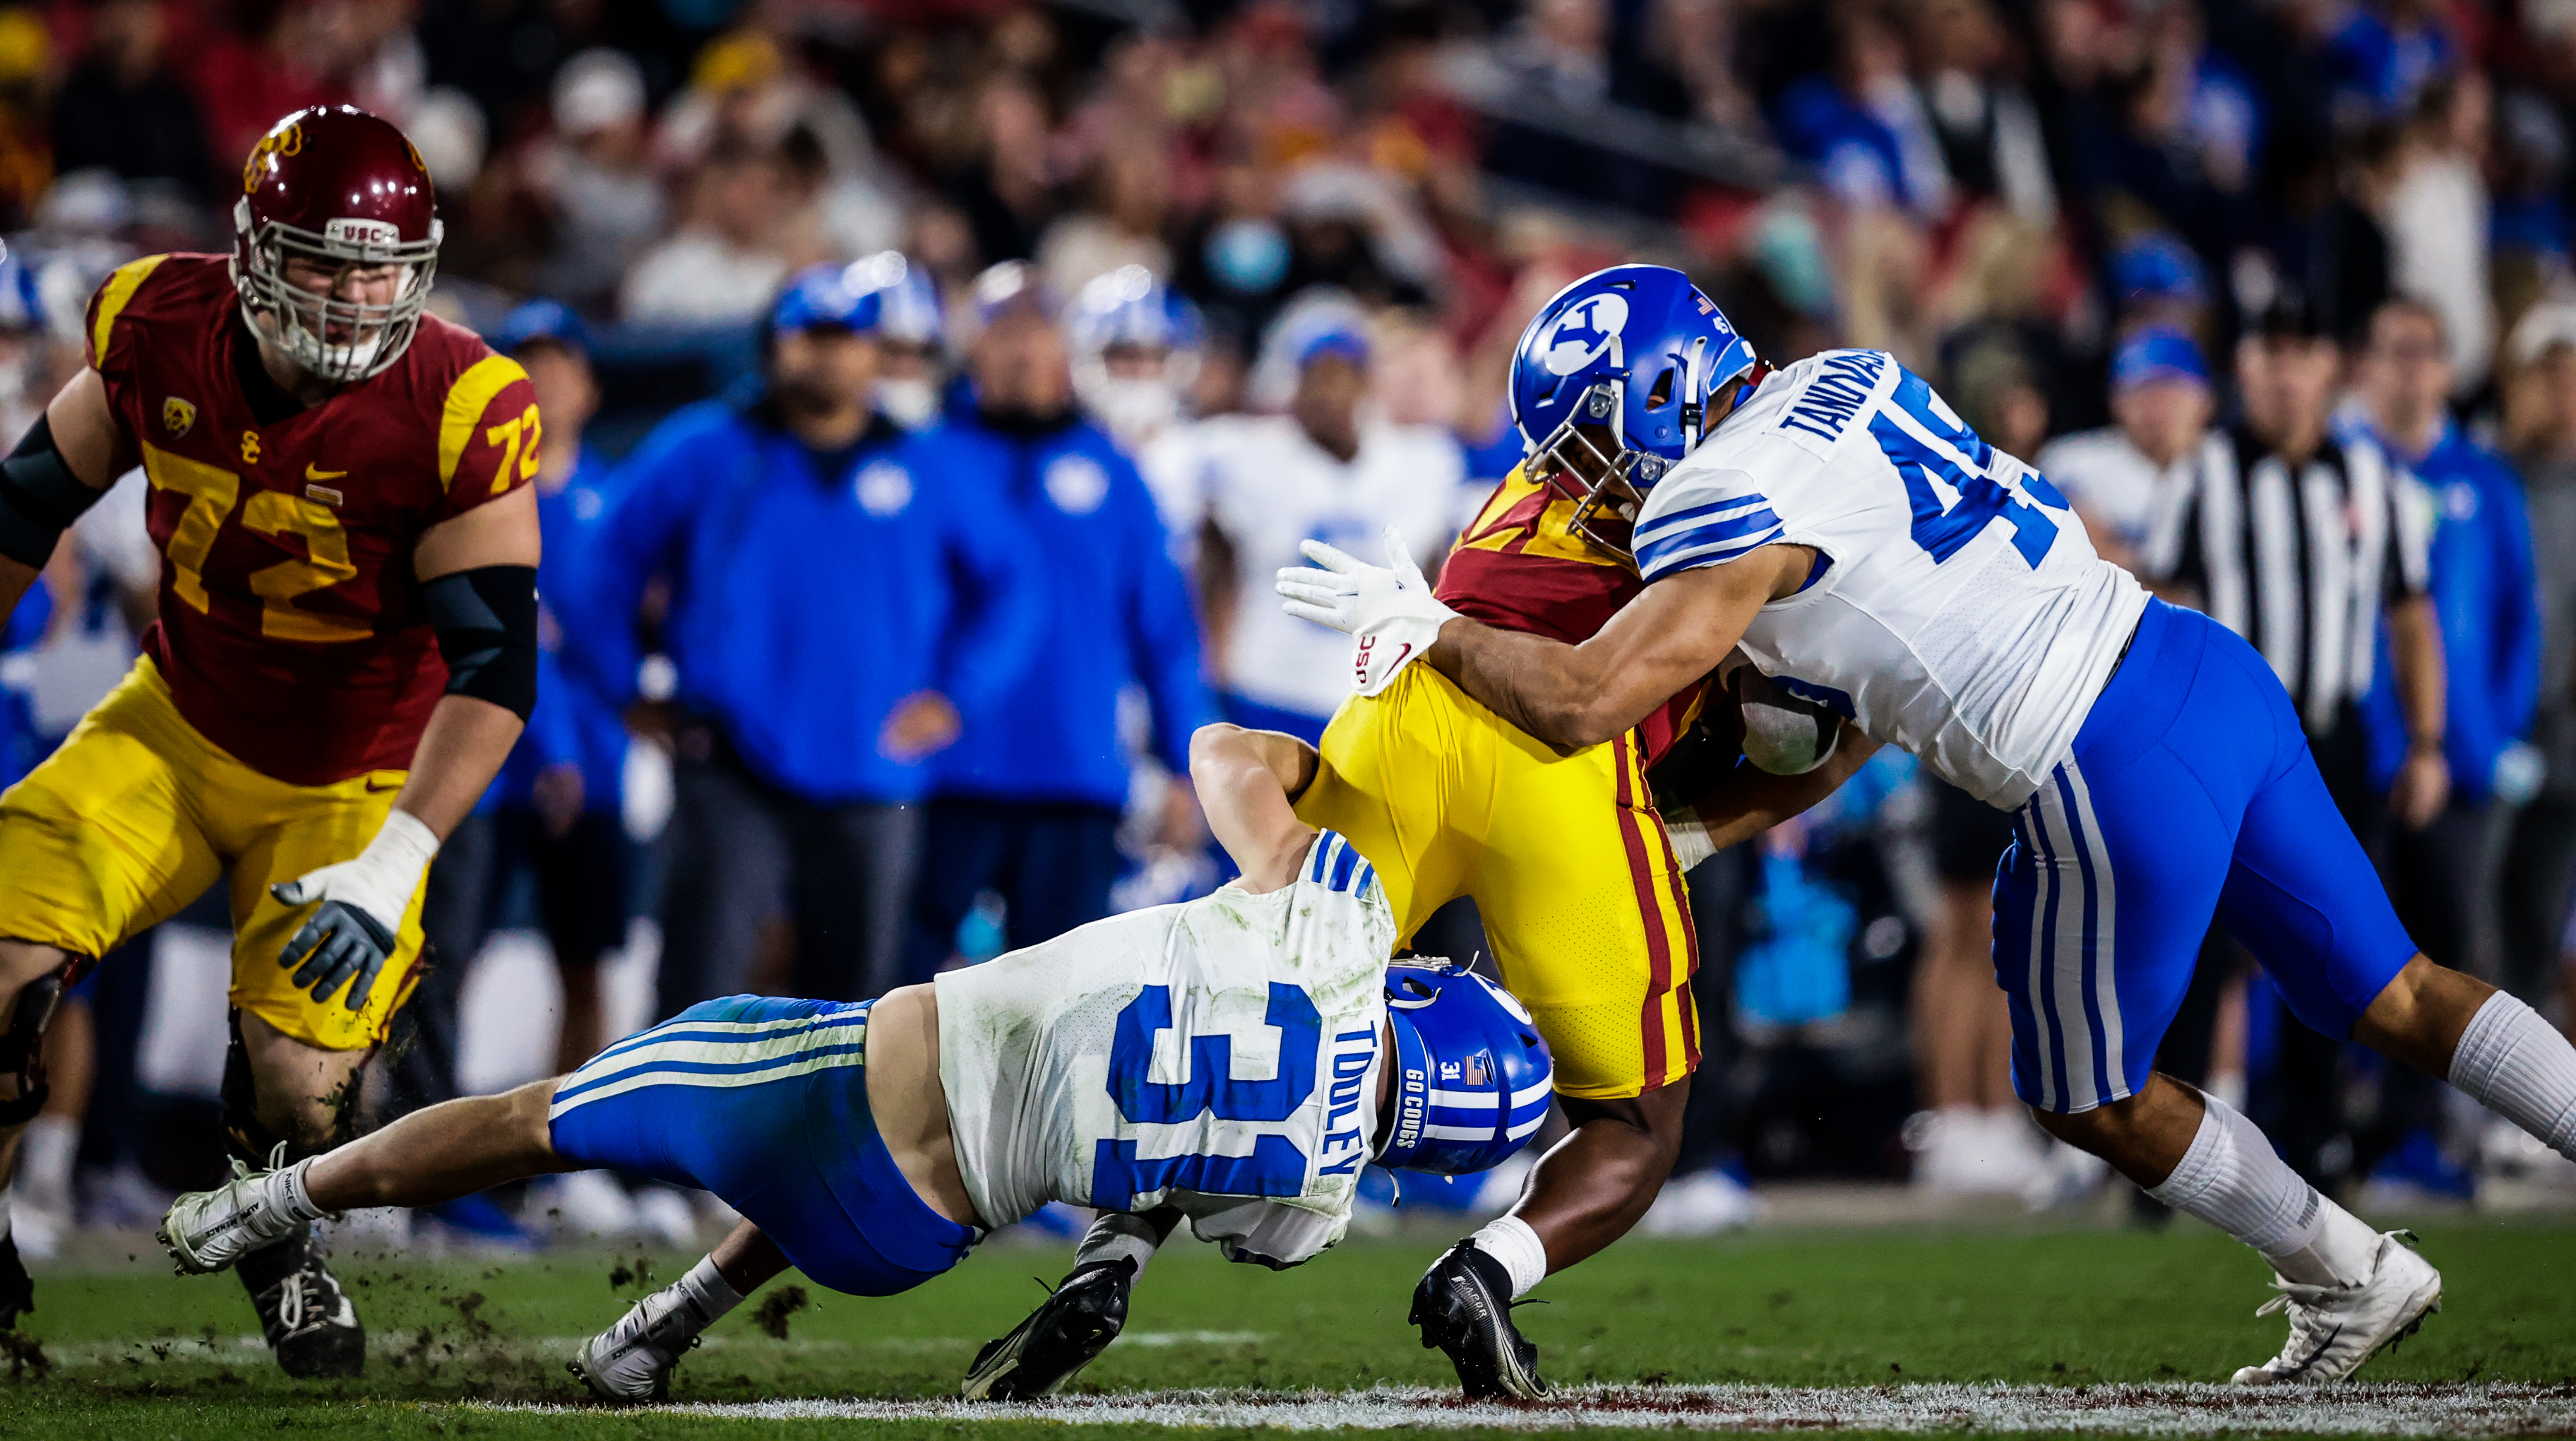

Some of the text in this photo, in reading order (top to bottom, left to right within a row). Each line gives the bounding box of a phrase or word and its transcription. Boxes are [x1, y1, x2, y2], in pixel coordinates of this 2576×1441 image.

[345, 225, 382, 242] USC
[487, 403, 542, 494] 72
[1867, 361, 2070, 571] 45
[142, 439, 374, 643] 72
[1090, 981, 1323, 1211] 31
[1396, 1068, 1424, 1149] GO COUGS
[1440, 1061, 1461, 1081] 31
[204, 1217, 237, 1239] MENACE
[285, 1173, 296, 1205] NIKE
